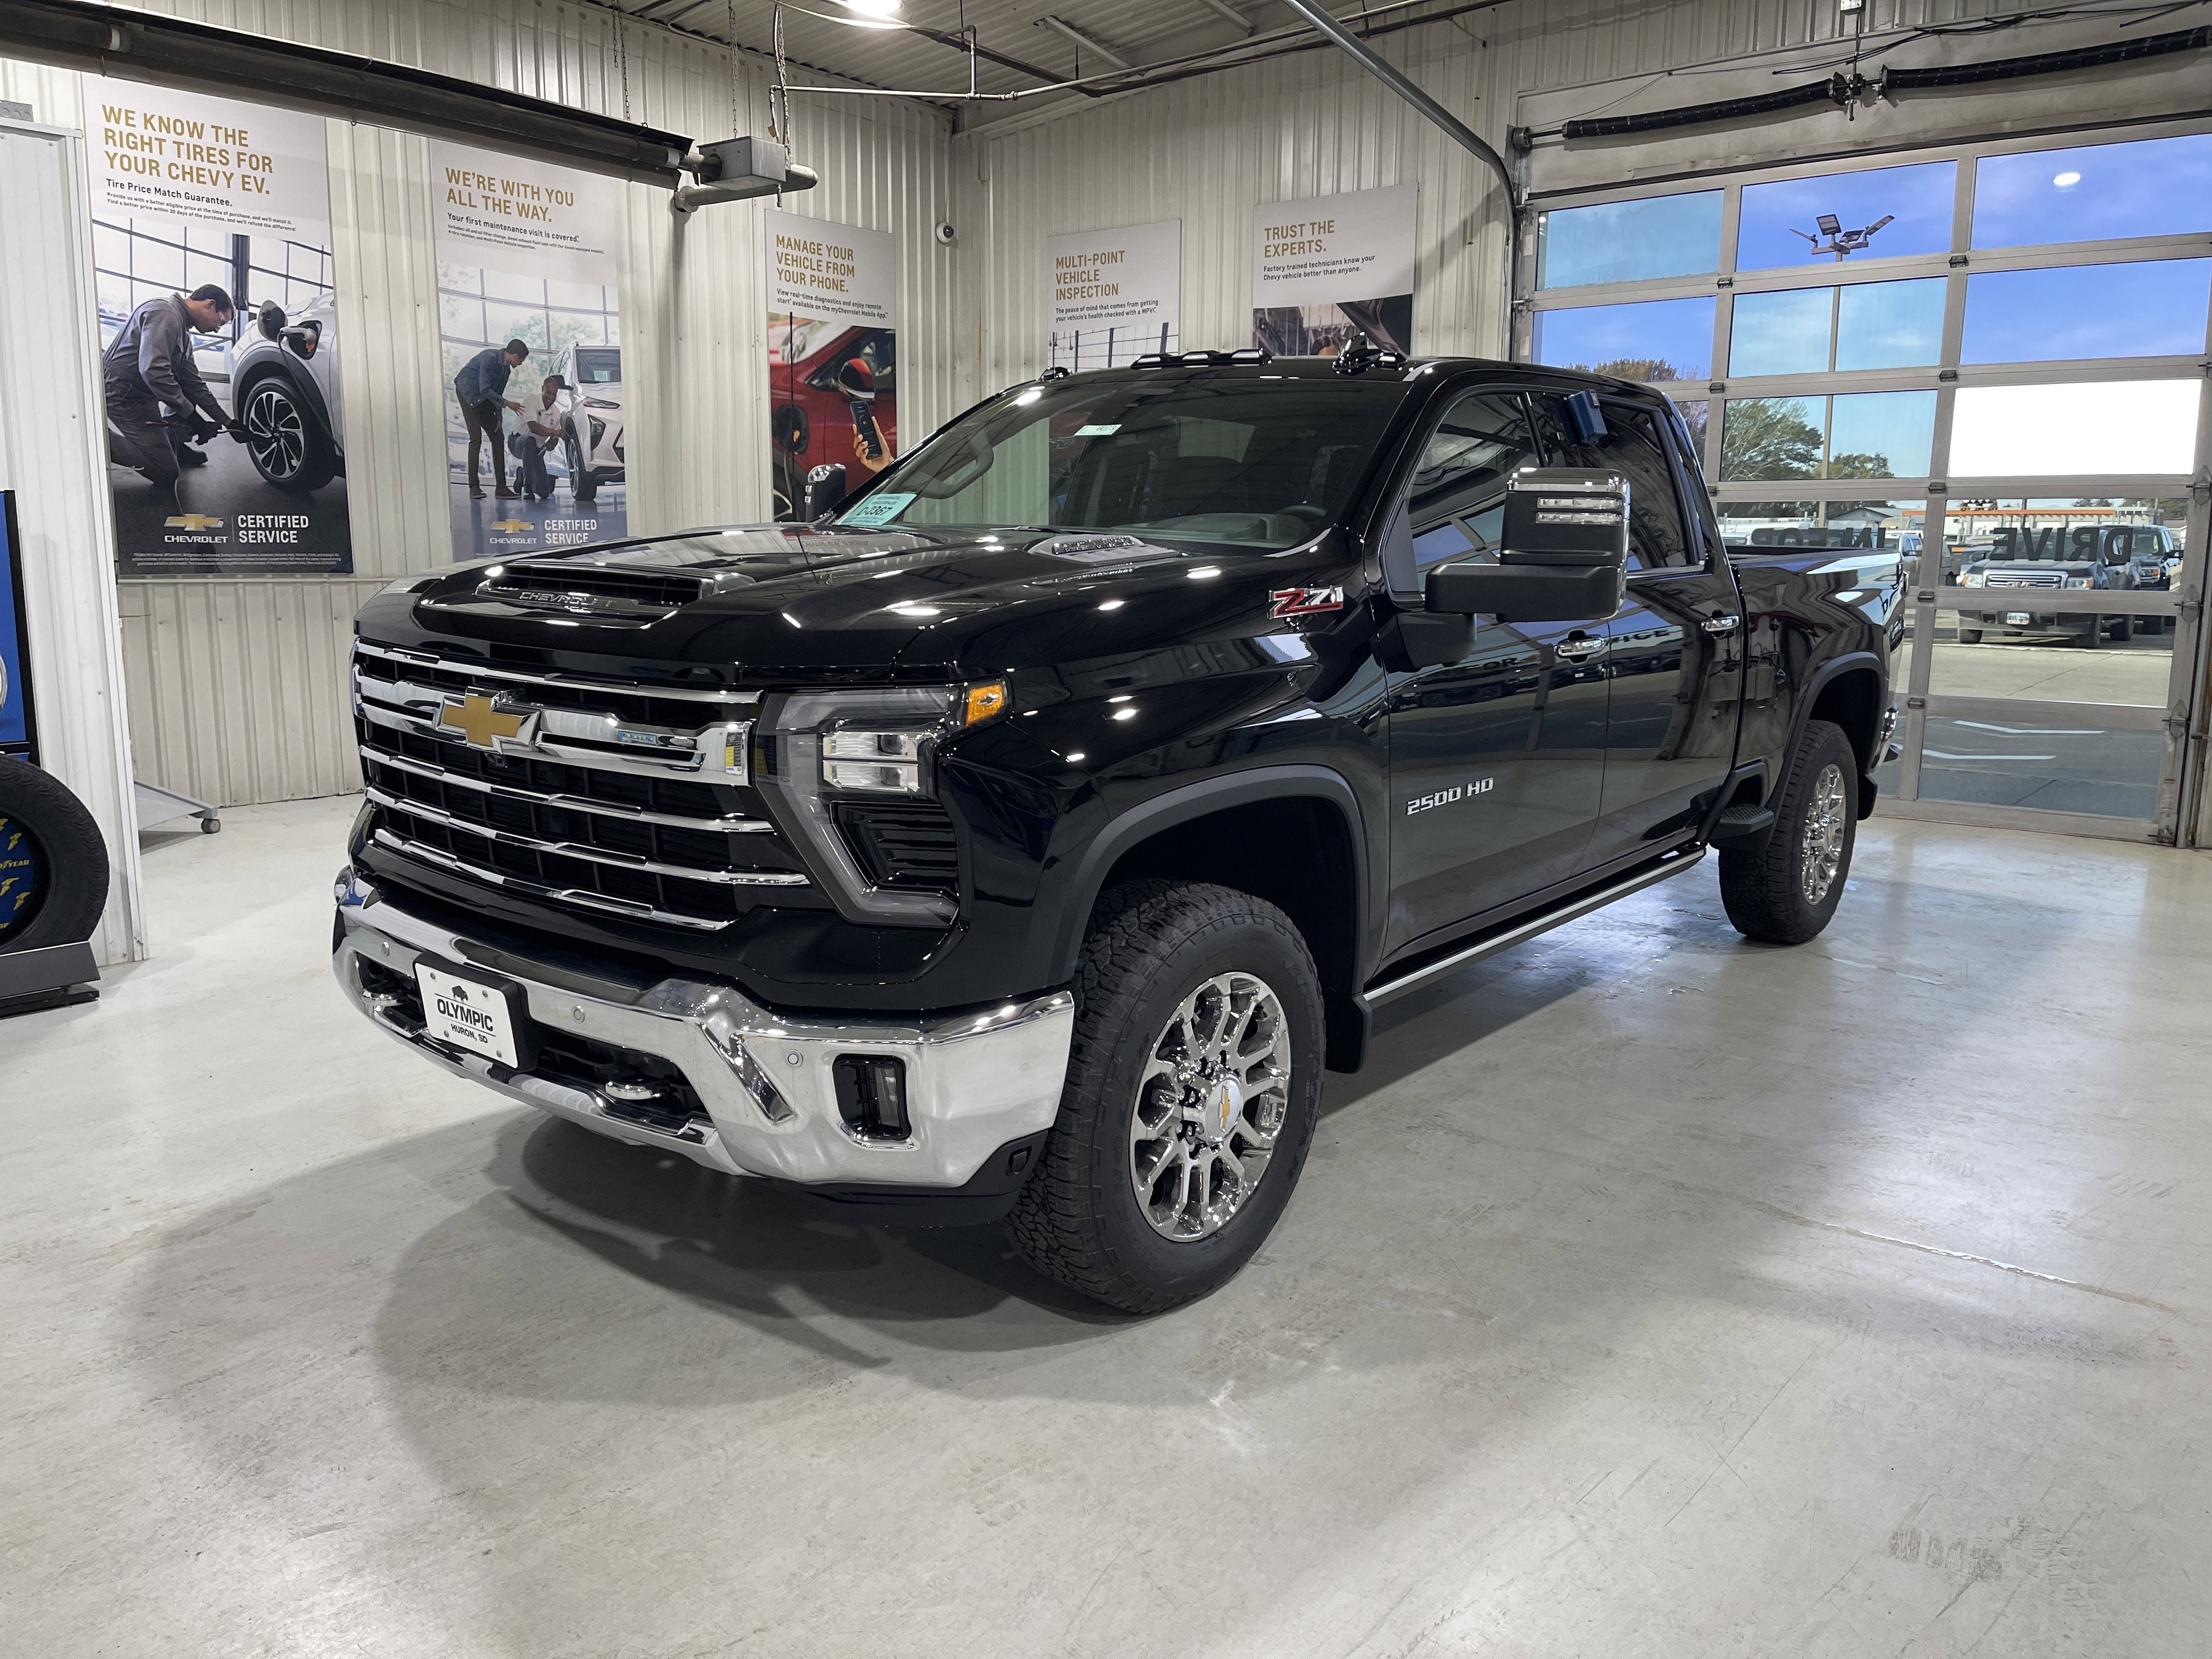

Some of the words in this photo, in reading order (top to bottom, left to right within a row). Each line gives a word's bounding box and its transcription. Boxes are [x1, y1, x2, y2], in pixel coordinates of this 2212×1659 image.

[102, 105, 136, 127] WE
[144, 113, 204, 139] KNOW
[211, 125, 249, 148] THE
[105, 128, 166, 155] RIGHT
[173, 140, 229, 166] TIRES
[237, 151, 273, 173] FOR
[104, 151, 160, 177] YOUR
[168, 163, 235, 188] CHEVY
[241, 174, 270, 194] EV.
[106, 178, 125, 189] Tire
[128, 182, 151, 193] Price
[155, 187, 181, 199] Match
[185, 192, 232, 206] Guarantee.
[445, 167, 496, 193] WE'RE
[501, 179, 540, 201] WITH
[545, 188, 573, 206] YOU
[447, 188, 477, 208] ALL
[482, 195, 511, 215] THE
[516, 202, 551, 222] WAY.
[448, 212, 464, 222] Your
[466, 216, 482, 226] first
[484, 222, 527, 234] maintenance
[1265, 224, 1306, 240] TRUST
[1310, 220, 1334, 235] THE
[777, 235, 822, 256] MANAGE
[826, 245, 854, 262] YOUR
[1264, 239, 1327, 258] EXPERTS.
[776, 251, 822, 272] VEHICLE
[826, 262, 855, 278] FROM
[1056, 250, 1125, 269] MULTI-POINT
[777, 268, 806, 285] YOUR
[810, 274, 848, 293] PHONE.
[1056, 269, 1100, 285] VEHICLE
[791, 292, 813, 300] real-time
[815, 295, 841, 304] diagnostics
[1056, 283, 1119, 301] INSPECTION
[831, 307, 860, 315] myChevrolet
[861, 308, 876, 317] Mobile
[238, 515, 309, 528] CERTIFIED
[544, 520, 597, 531] CERTIFIED
[165, 535, 228, 543] CHEVROLET
[239, 530, 298, 544] SERVICE
[545, 533, 589, 544] SERVICE
[1268, 585, 1344, 619] Z71
[1406, 786, 1462, 815] 2500
[1466, 777, 1493, 797] HD
[437, 998, 493, 1031] OLYMPIC
[451, 1023, 477, 1041] HURON,
[478, 1034, 488, 1043] SD
